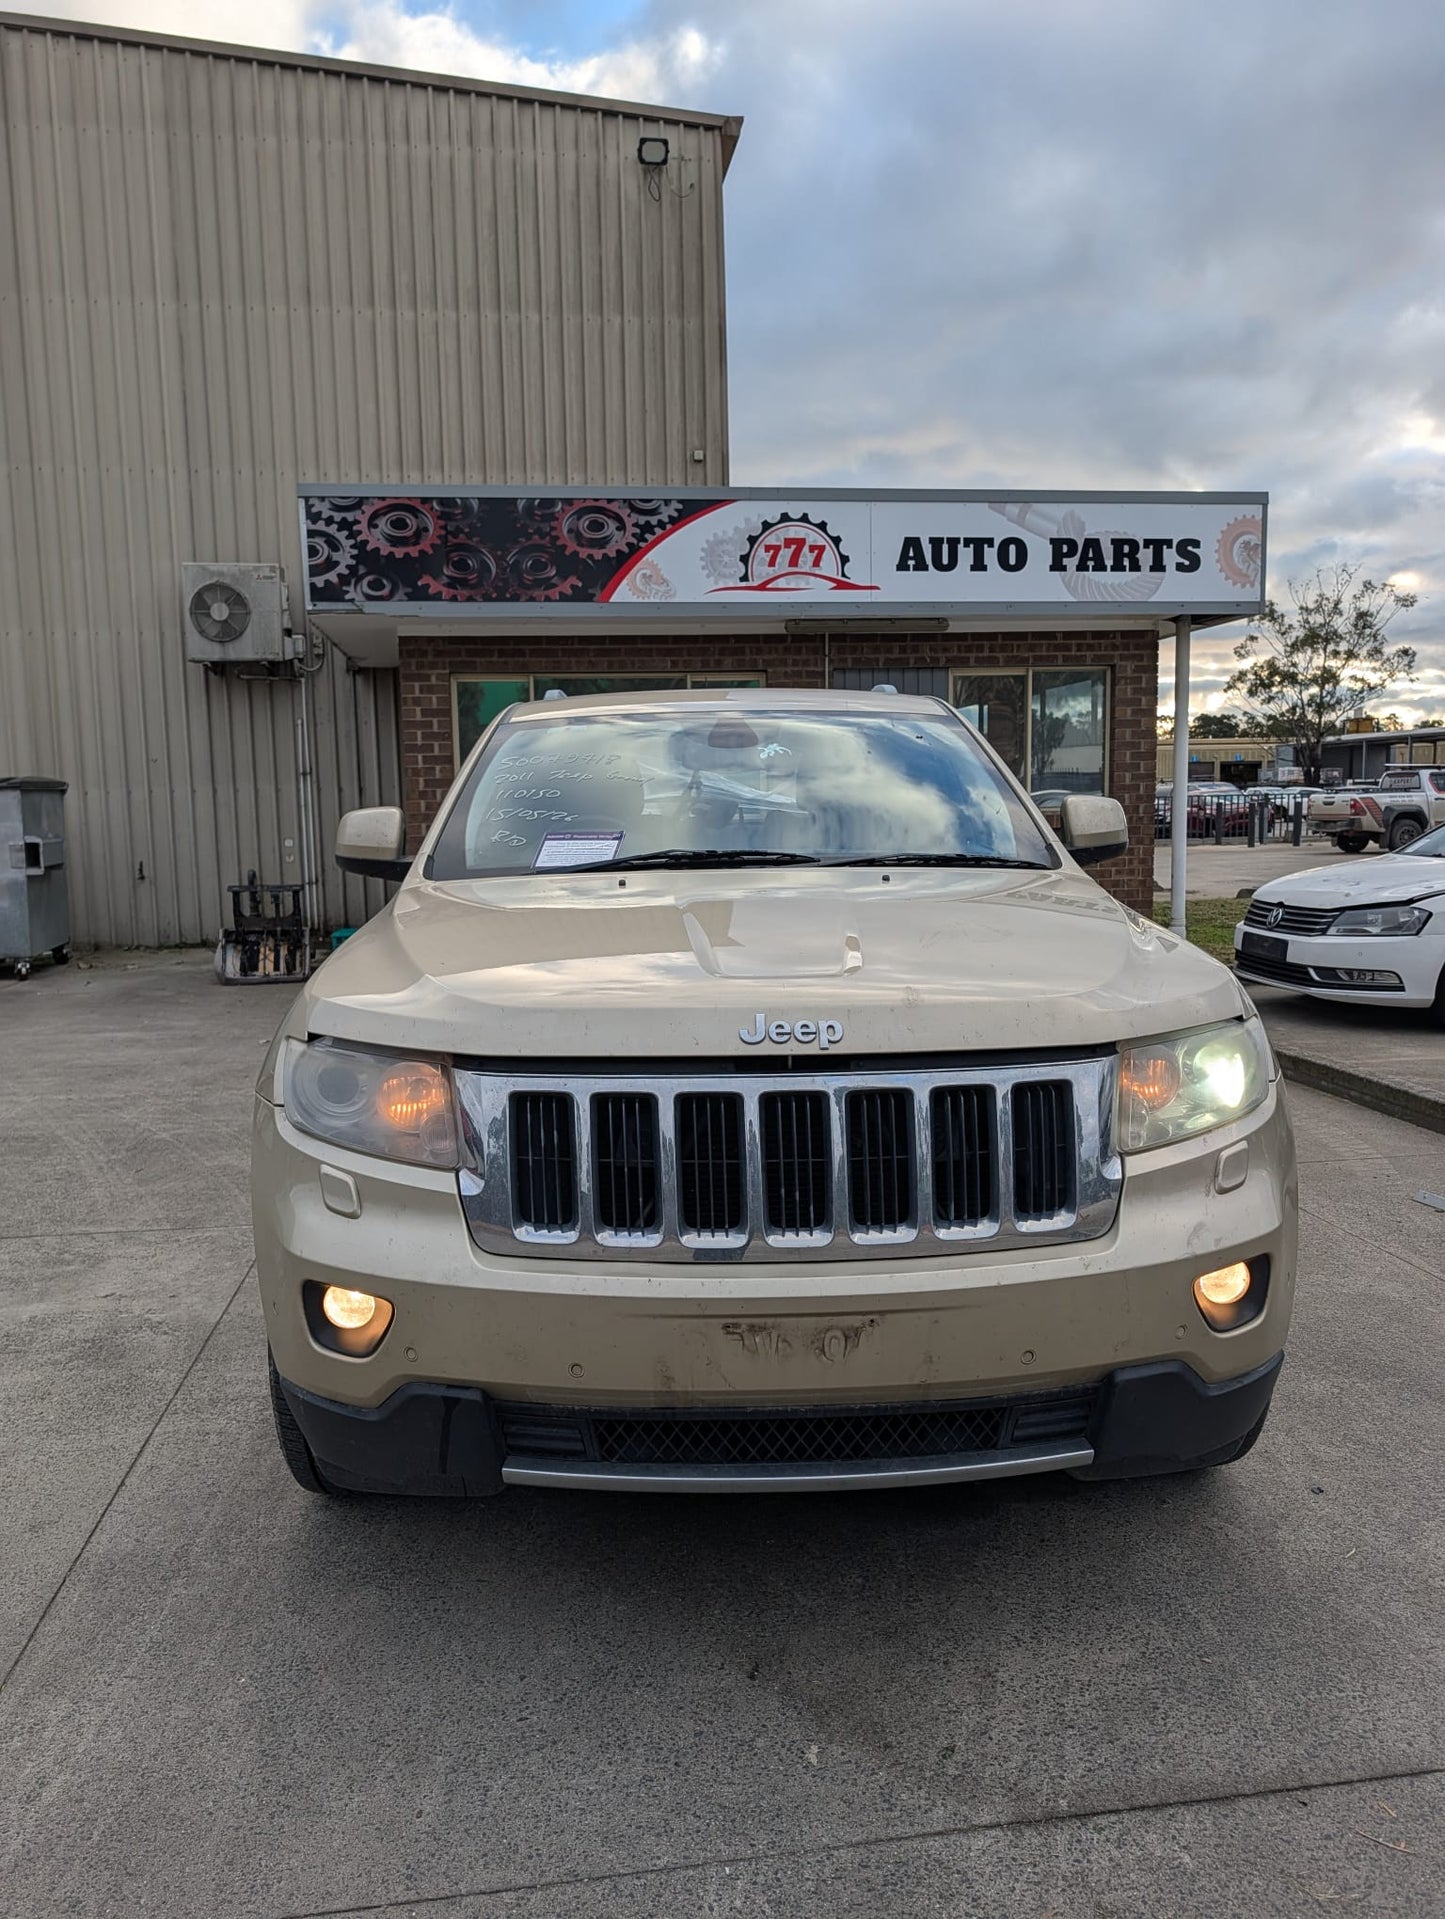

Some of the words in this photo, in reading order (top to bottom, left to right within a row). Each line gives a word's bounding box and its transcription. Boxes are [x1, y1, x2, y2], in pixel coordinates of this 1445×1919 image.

[763, 537, 827, 568] 777
[895, 535, 1029, 573] AUTO
[1049, 537, 1202, 574] PARTS
[738, 1012, 844, 1051] Jeep
